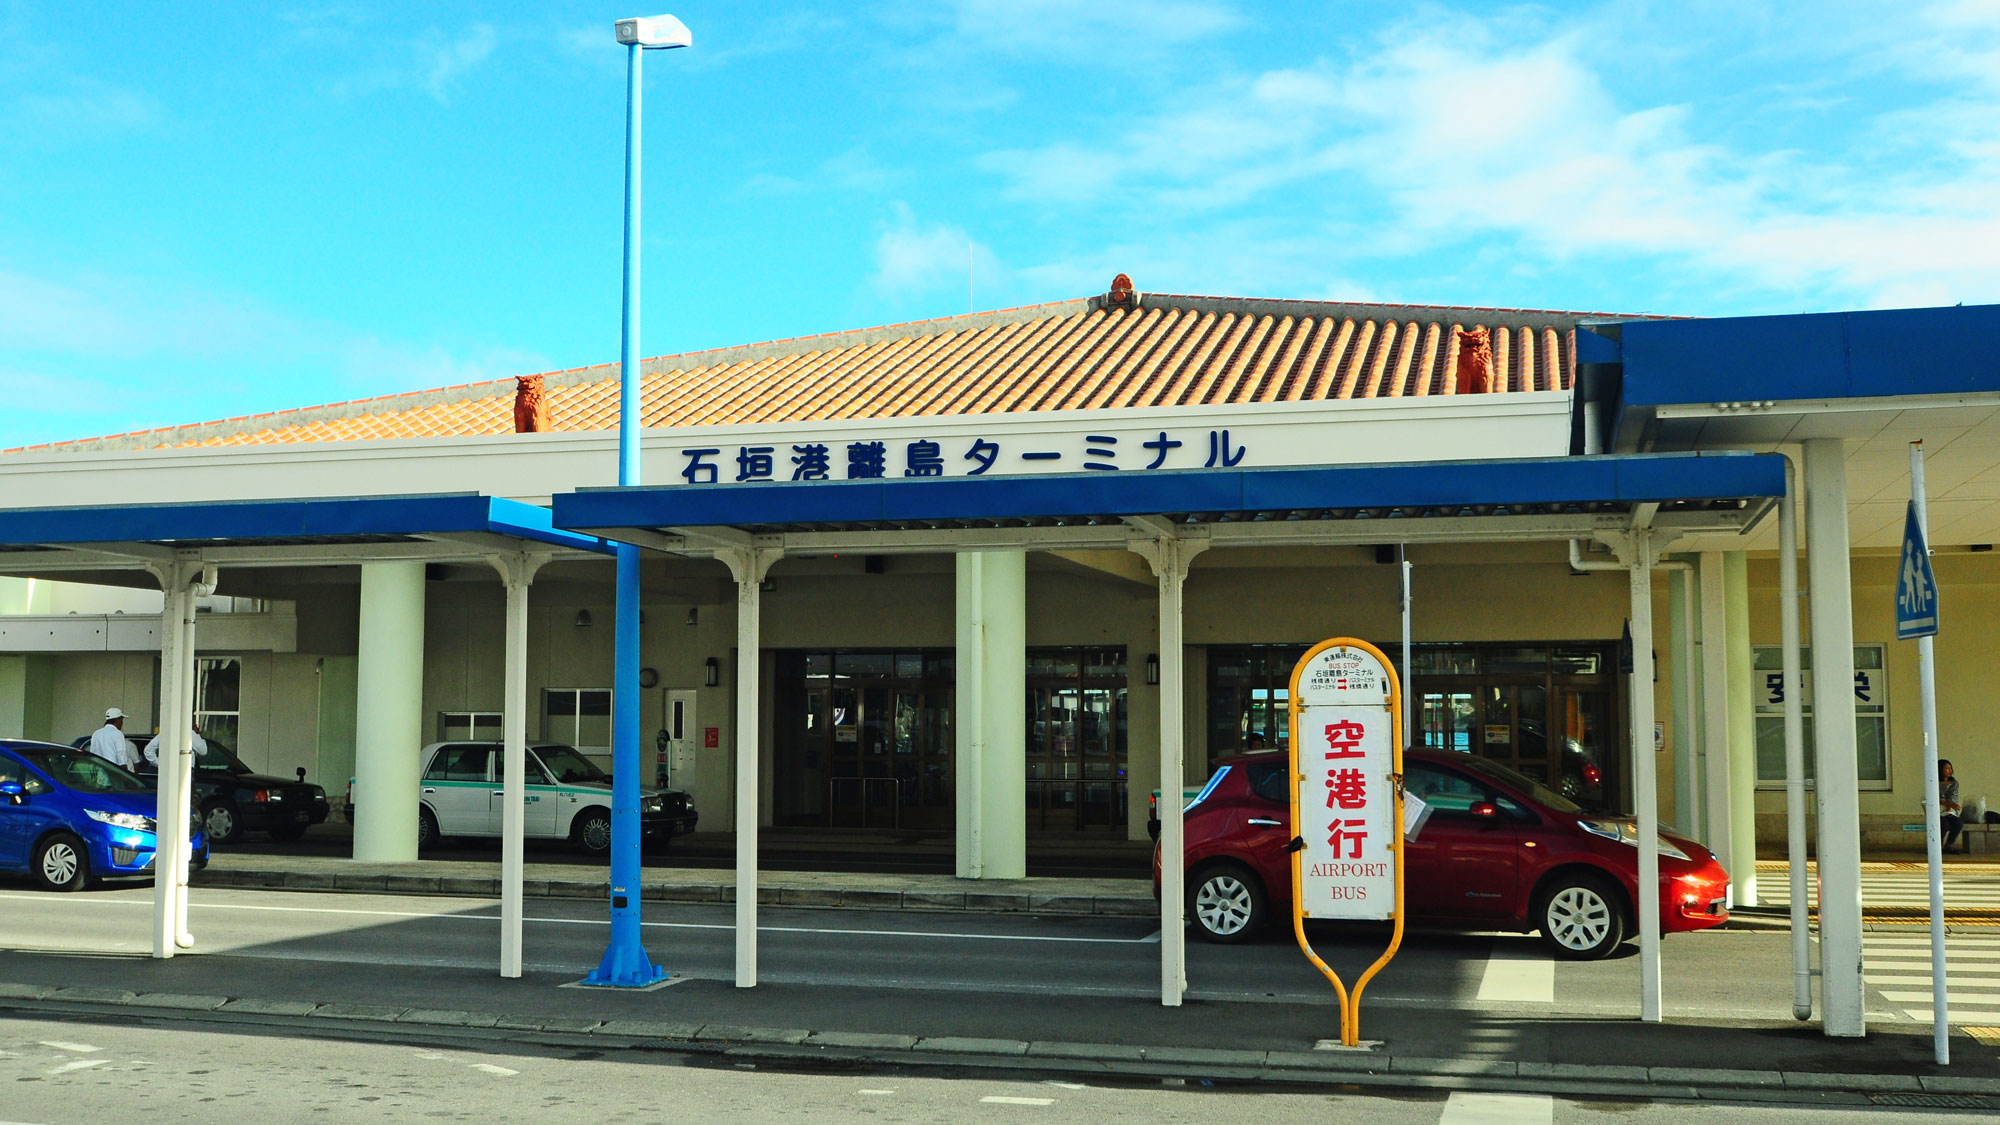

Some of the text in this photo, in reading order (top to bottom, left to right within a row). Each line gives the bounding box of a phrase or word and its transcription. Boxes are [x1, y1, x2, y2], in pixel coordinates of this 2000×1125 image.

[681, 429, 1247, 484] 石垣港離島ターミナル
[1316, 669, 1373, 677] 石垣離島ターミナル
[1325, 719, 1368, 859] 空港行
[1310, 863, 1387, 877] AIRPORT
[1332, 886, 1367, 900] BUS
